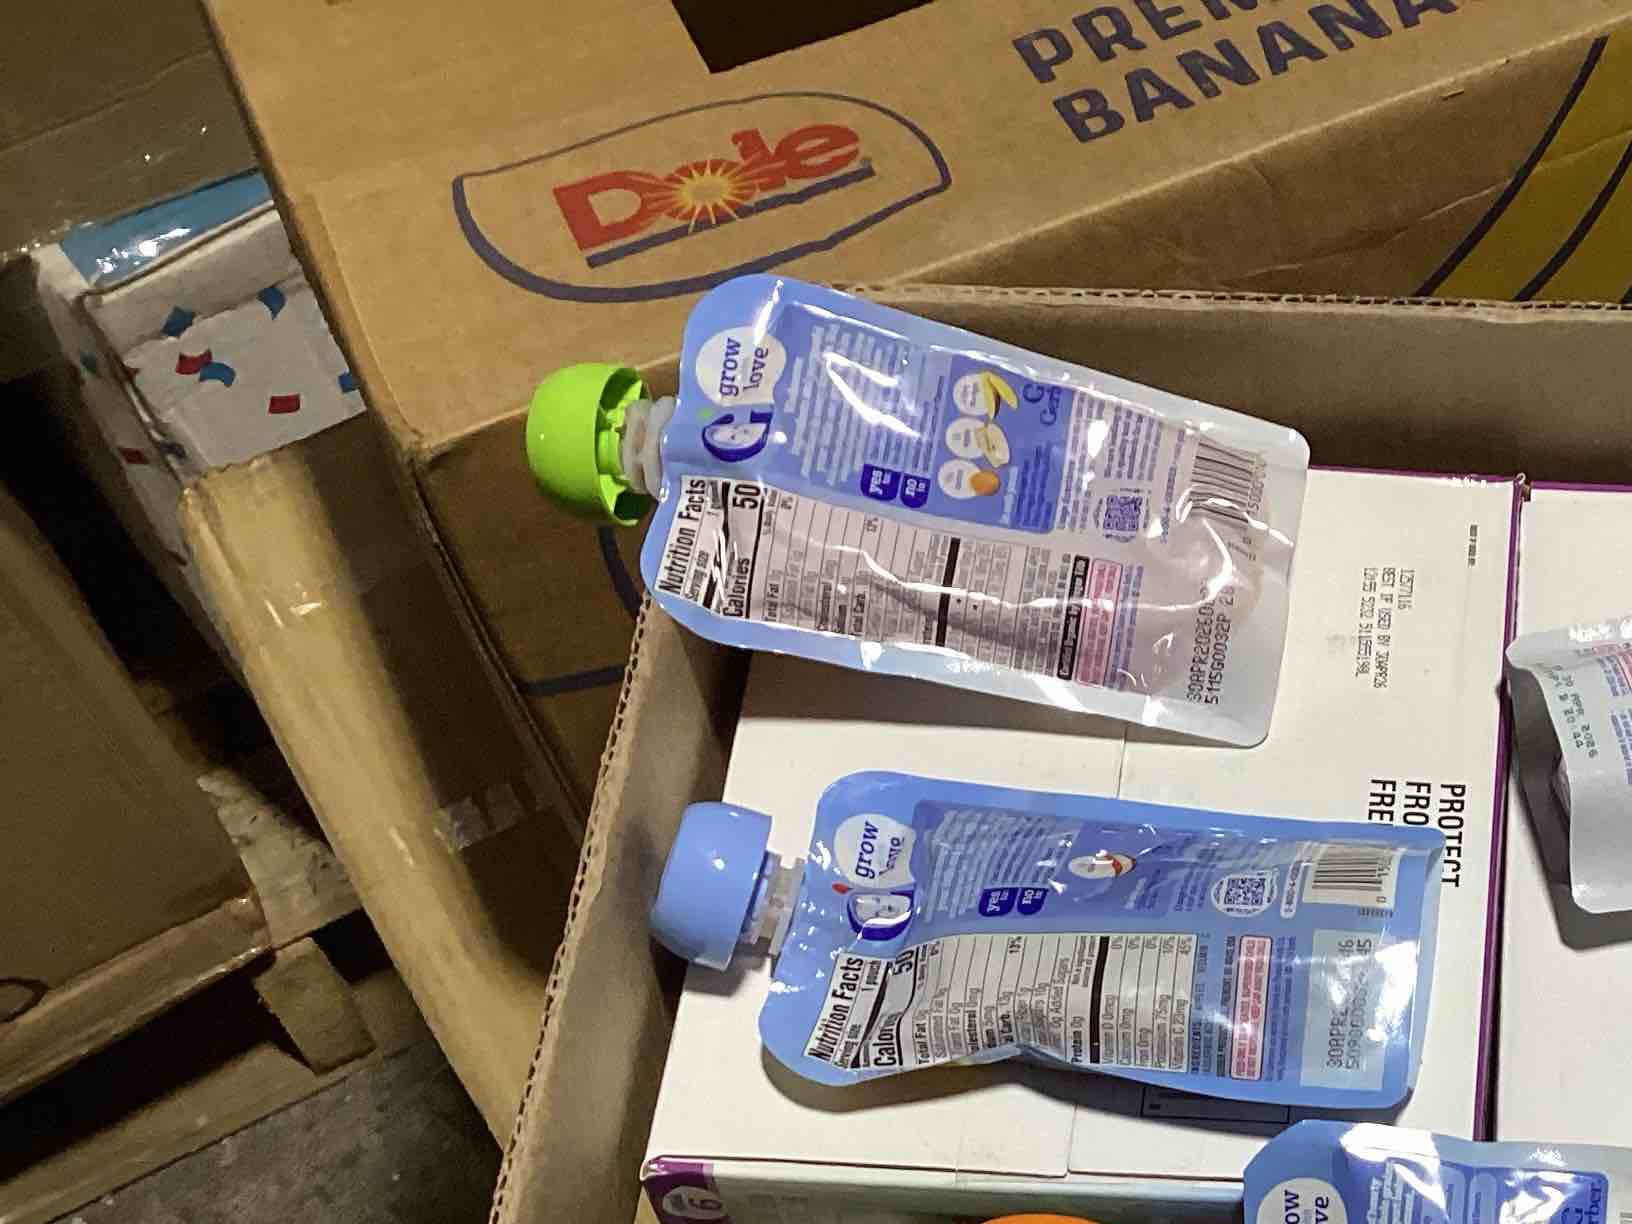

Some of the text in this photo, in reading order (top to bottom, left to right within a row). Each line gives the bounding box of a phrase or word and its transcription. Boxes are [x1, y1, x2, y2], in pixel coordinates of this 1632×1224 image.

[552, 123, 860, 251] Dole
[717, 336, 743, 397] grow
[743, 346, 769, 392] love
[867, 469, 884, 496] yes
[904, 479, 918, 497] no
[658, 478, 706, 595] Nutrition Facts
[722, 484, 762, 618] Calories 50
[854, 821, 879, 880] grow
[1438, 783, 1466, 888] PROTECT
[1021, 889, 1035, 905] no
[890, 949, 914, 976] 50
[808, 956, 864, 1062] Nutrition Facts
[915, 1022, 931, 1065] Total Fat
